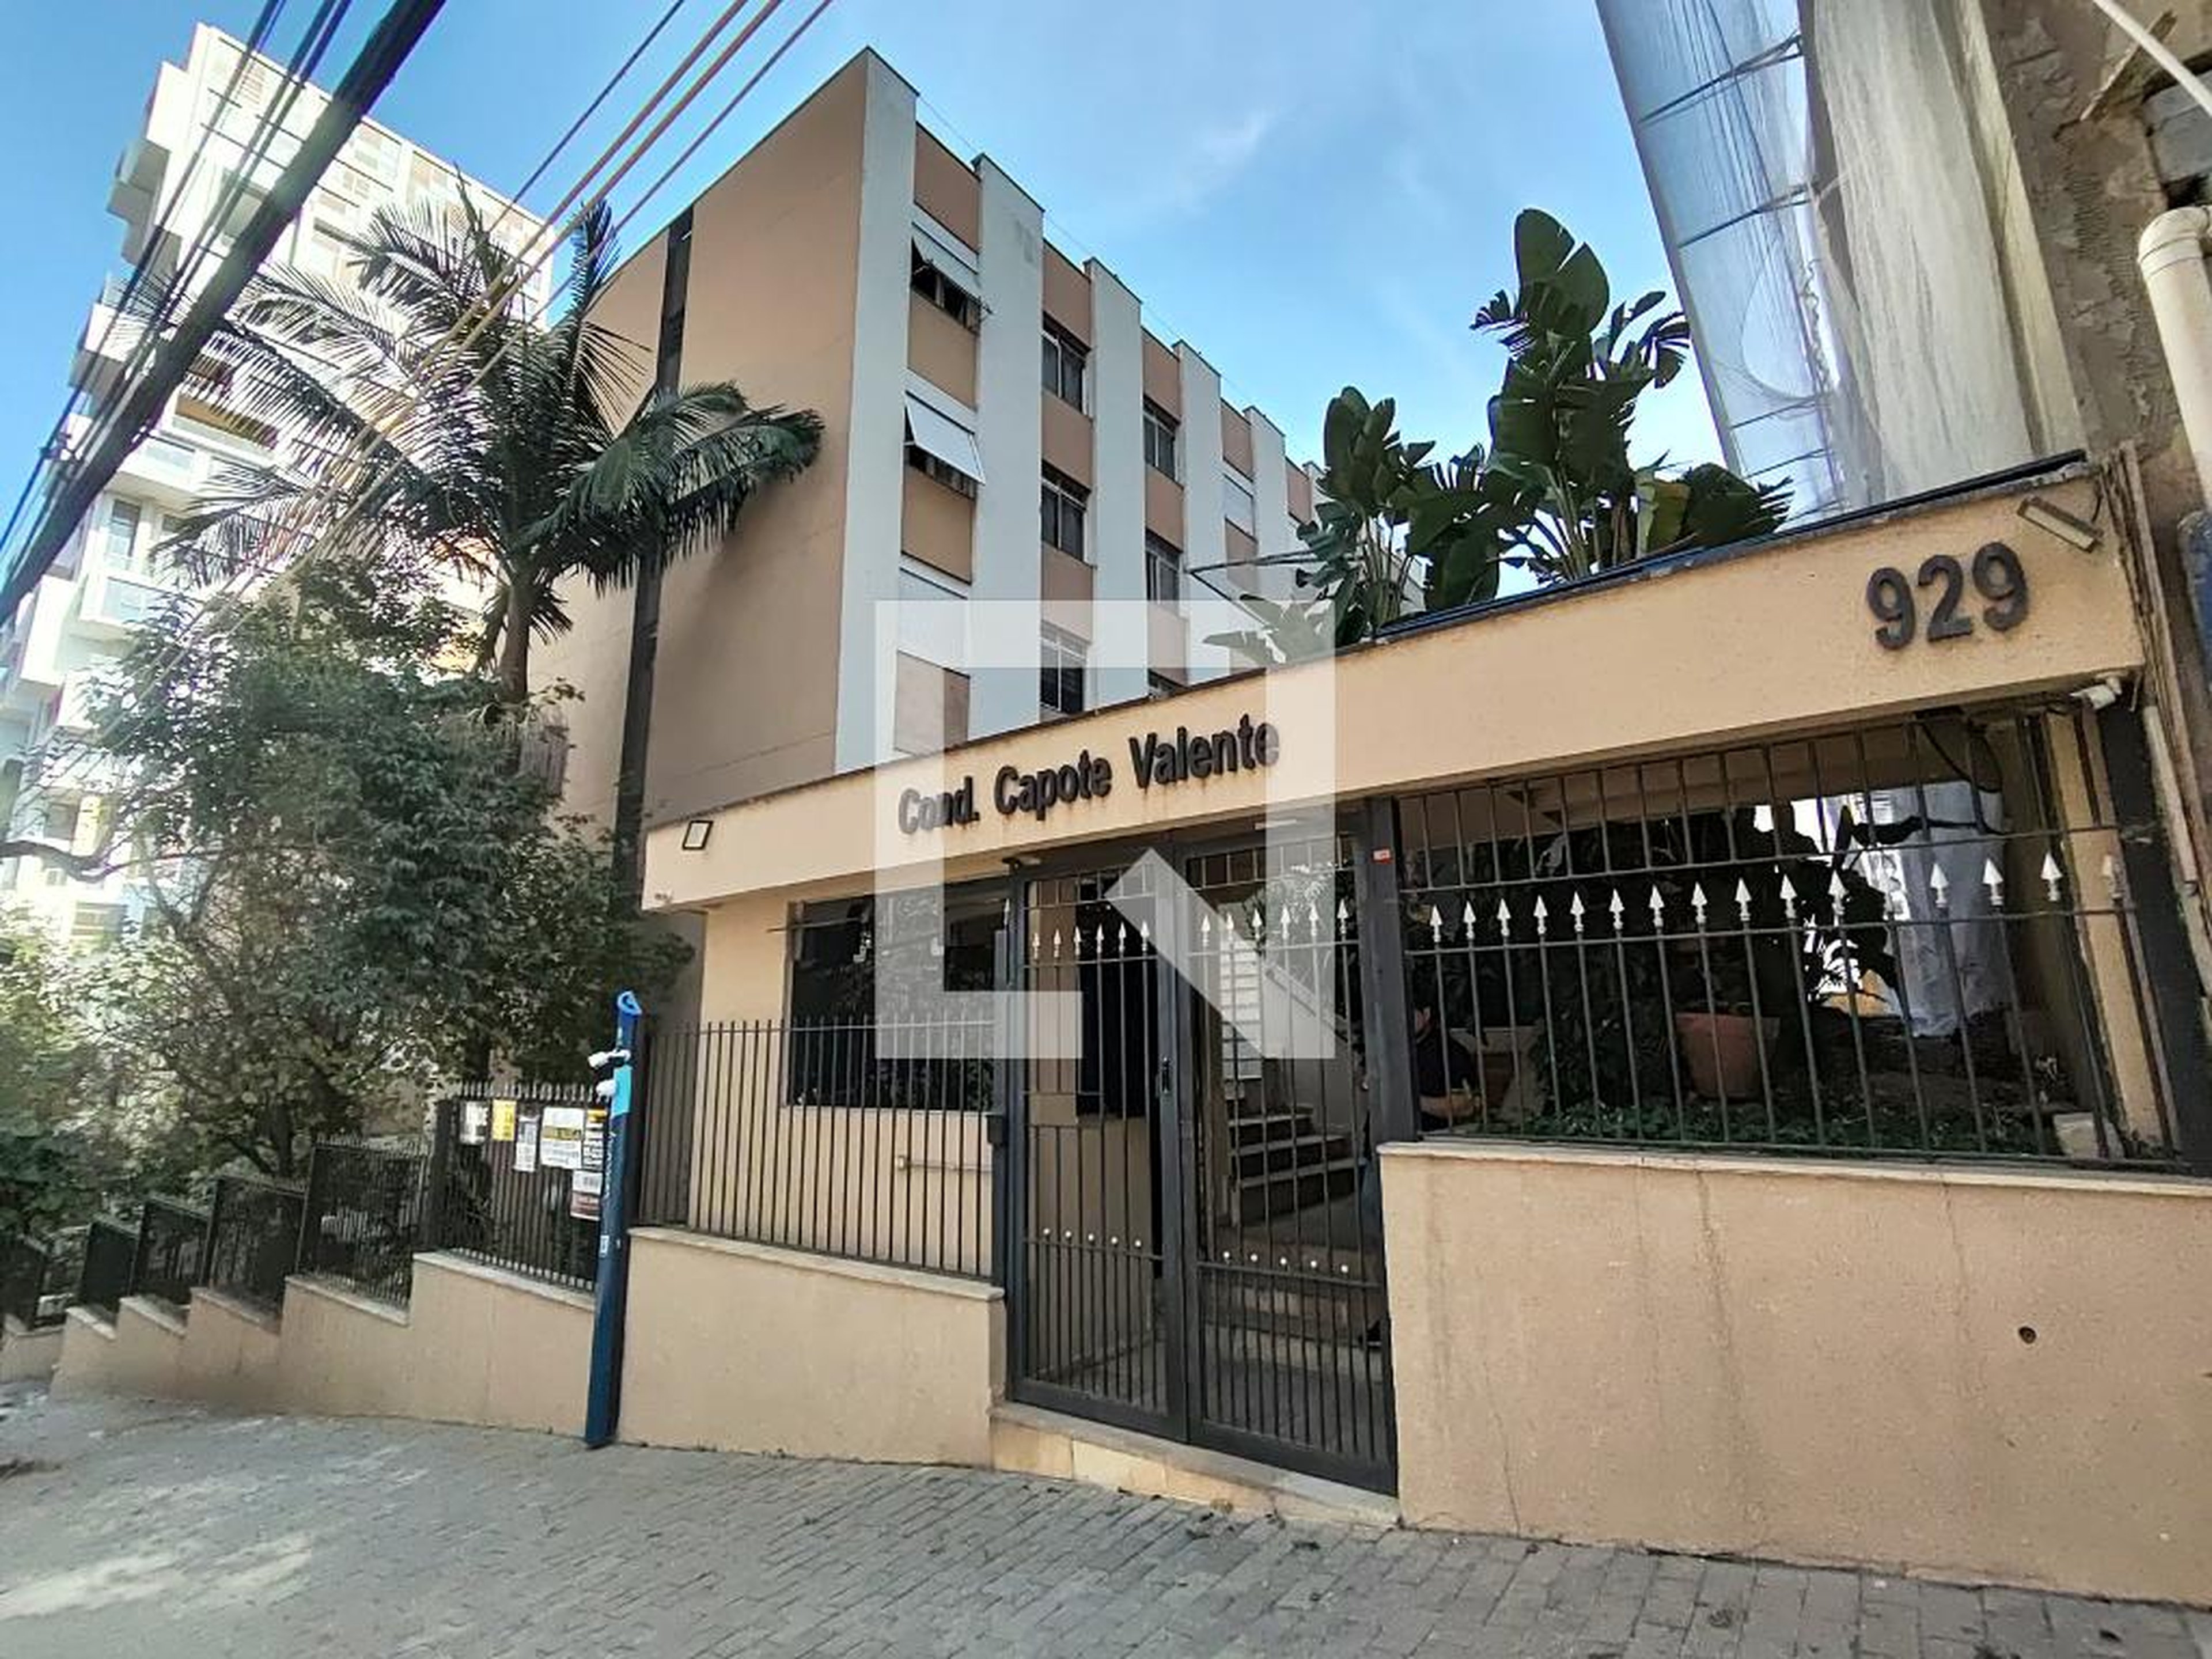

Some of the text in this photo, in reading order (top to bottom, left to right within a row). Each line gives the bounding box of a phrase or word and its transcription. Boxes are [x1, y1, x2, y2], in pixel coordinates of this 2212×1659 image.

[1866, 541, 2029, 650] 929
[898, 713, 1280, 835] Cond. Capote Valente
